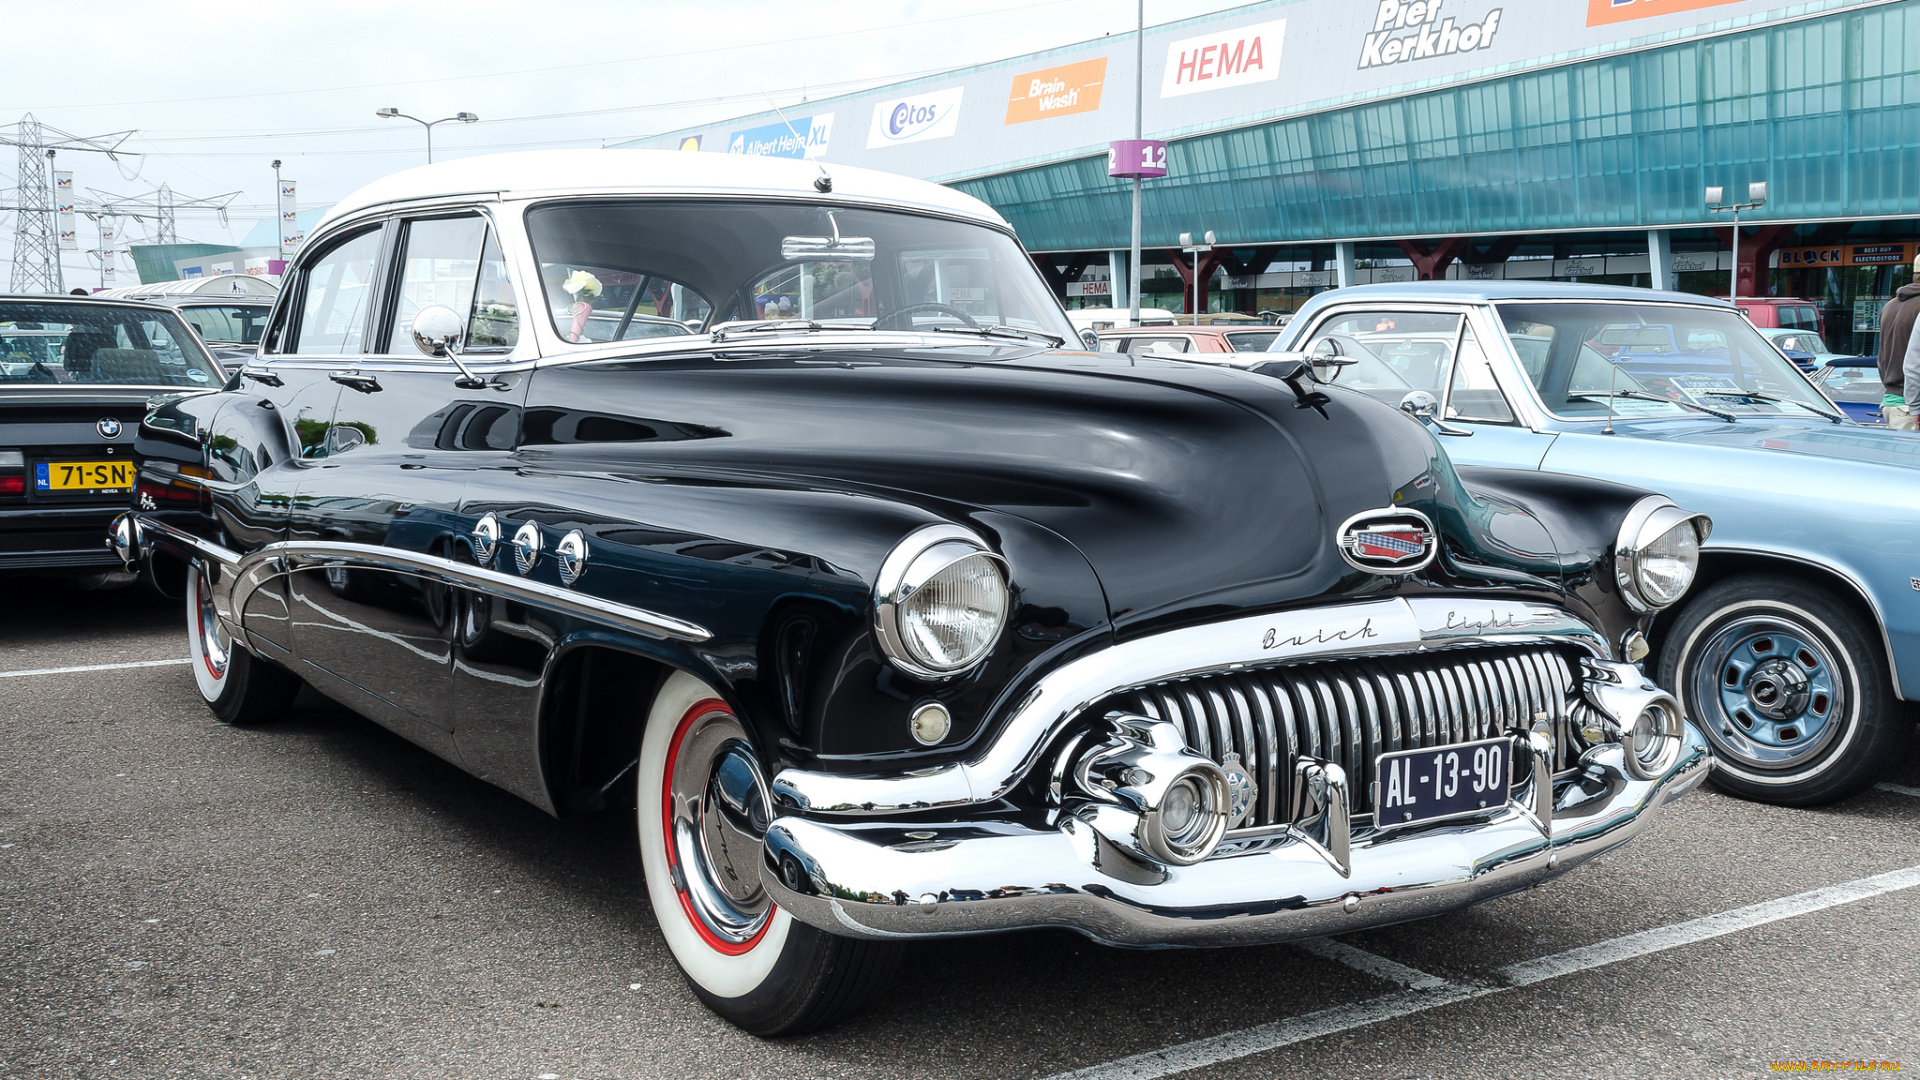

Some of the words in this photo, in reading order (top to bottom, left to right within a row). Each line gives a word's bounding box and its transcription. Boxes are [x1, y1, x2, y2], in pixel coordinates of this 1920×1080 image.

[1373, 0, 1443, 31] Piet
[1357, 7, 1503, 71] Kerkhof
[1176, 36, 1264, 85] HEMA
[1028, 77, 1065, 98] Brain
[1039, 89, 1079, 112] Wash
[747, 138, 777, 155] Albert
[777, 132, 806, 154] Heijn
[808, 125, 828, 146] XL
[1141, 145, 1166, 169] 12
[1082, 282, 1108, 295] HEMA
[1261, 618, 1378, 650] Buick
[1446, 609, 1519, 636] Eight
[1386, 745, 1502, 808] AL-13-90
